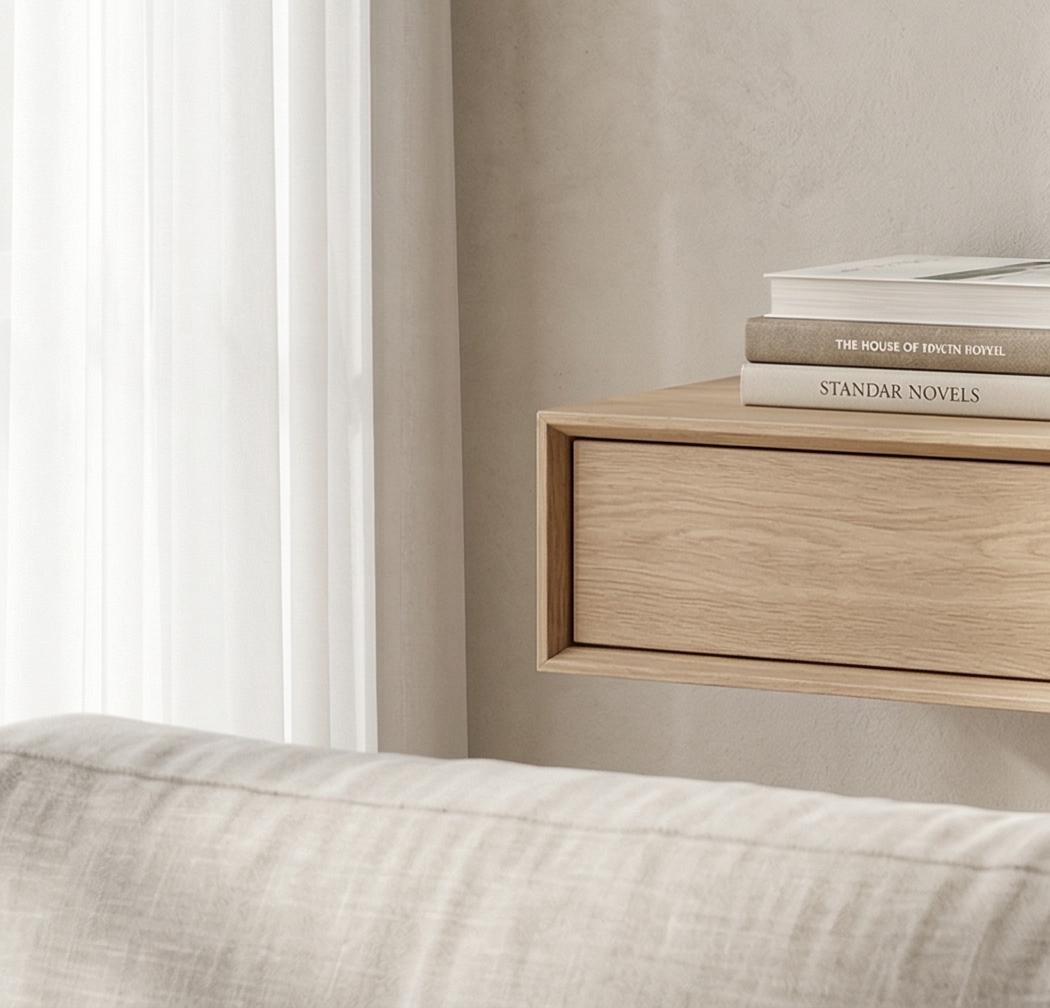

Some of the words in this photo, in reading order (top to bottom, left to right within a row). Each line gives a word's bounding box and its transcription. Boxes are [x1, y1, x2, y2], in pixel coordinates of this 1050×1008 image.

[835, 339, 858, 350] THE
[861, 340, 900, 352] HOUSE
[903, 342, 919, 353] OF
[820, 380, 902, 399] STANDAR
[909, 385, 980, 403] NOVELS
